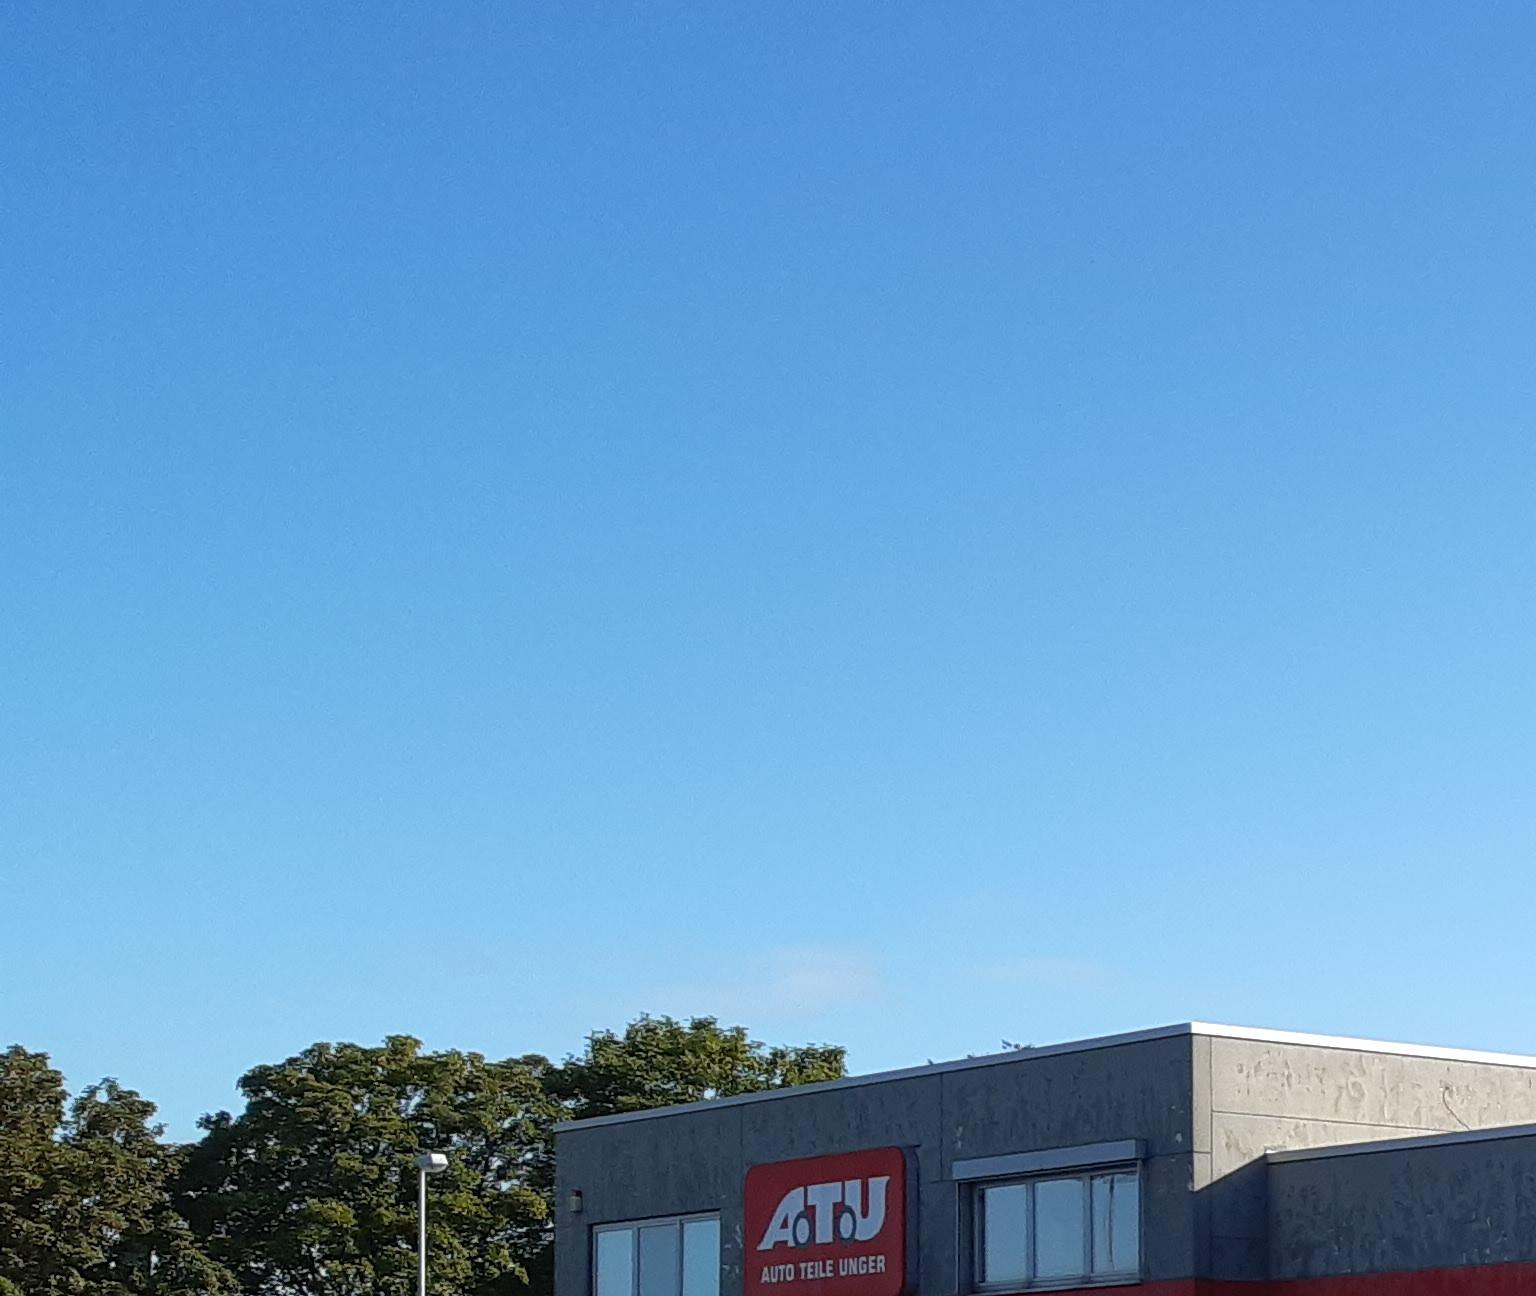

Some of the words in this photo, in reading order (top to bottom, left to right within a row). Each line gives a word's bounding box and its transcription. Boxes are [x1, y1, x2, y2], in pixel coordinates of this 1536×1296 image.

[756, 1175, 890, 1251] ATU
[760, 1262, 796, 1284] AUTO
[799, 1258, 834, 1279] TEILE
[838, 1254, 886, 1276] UNGER
